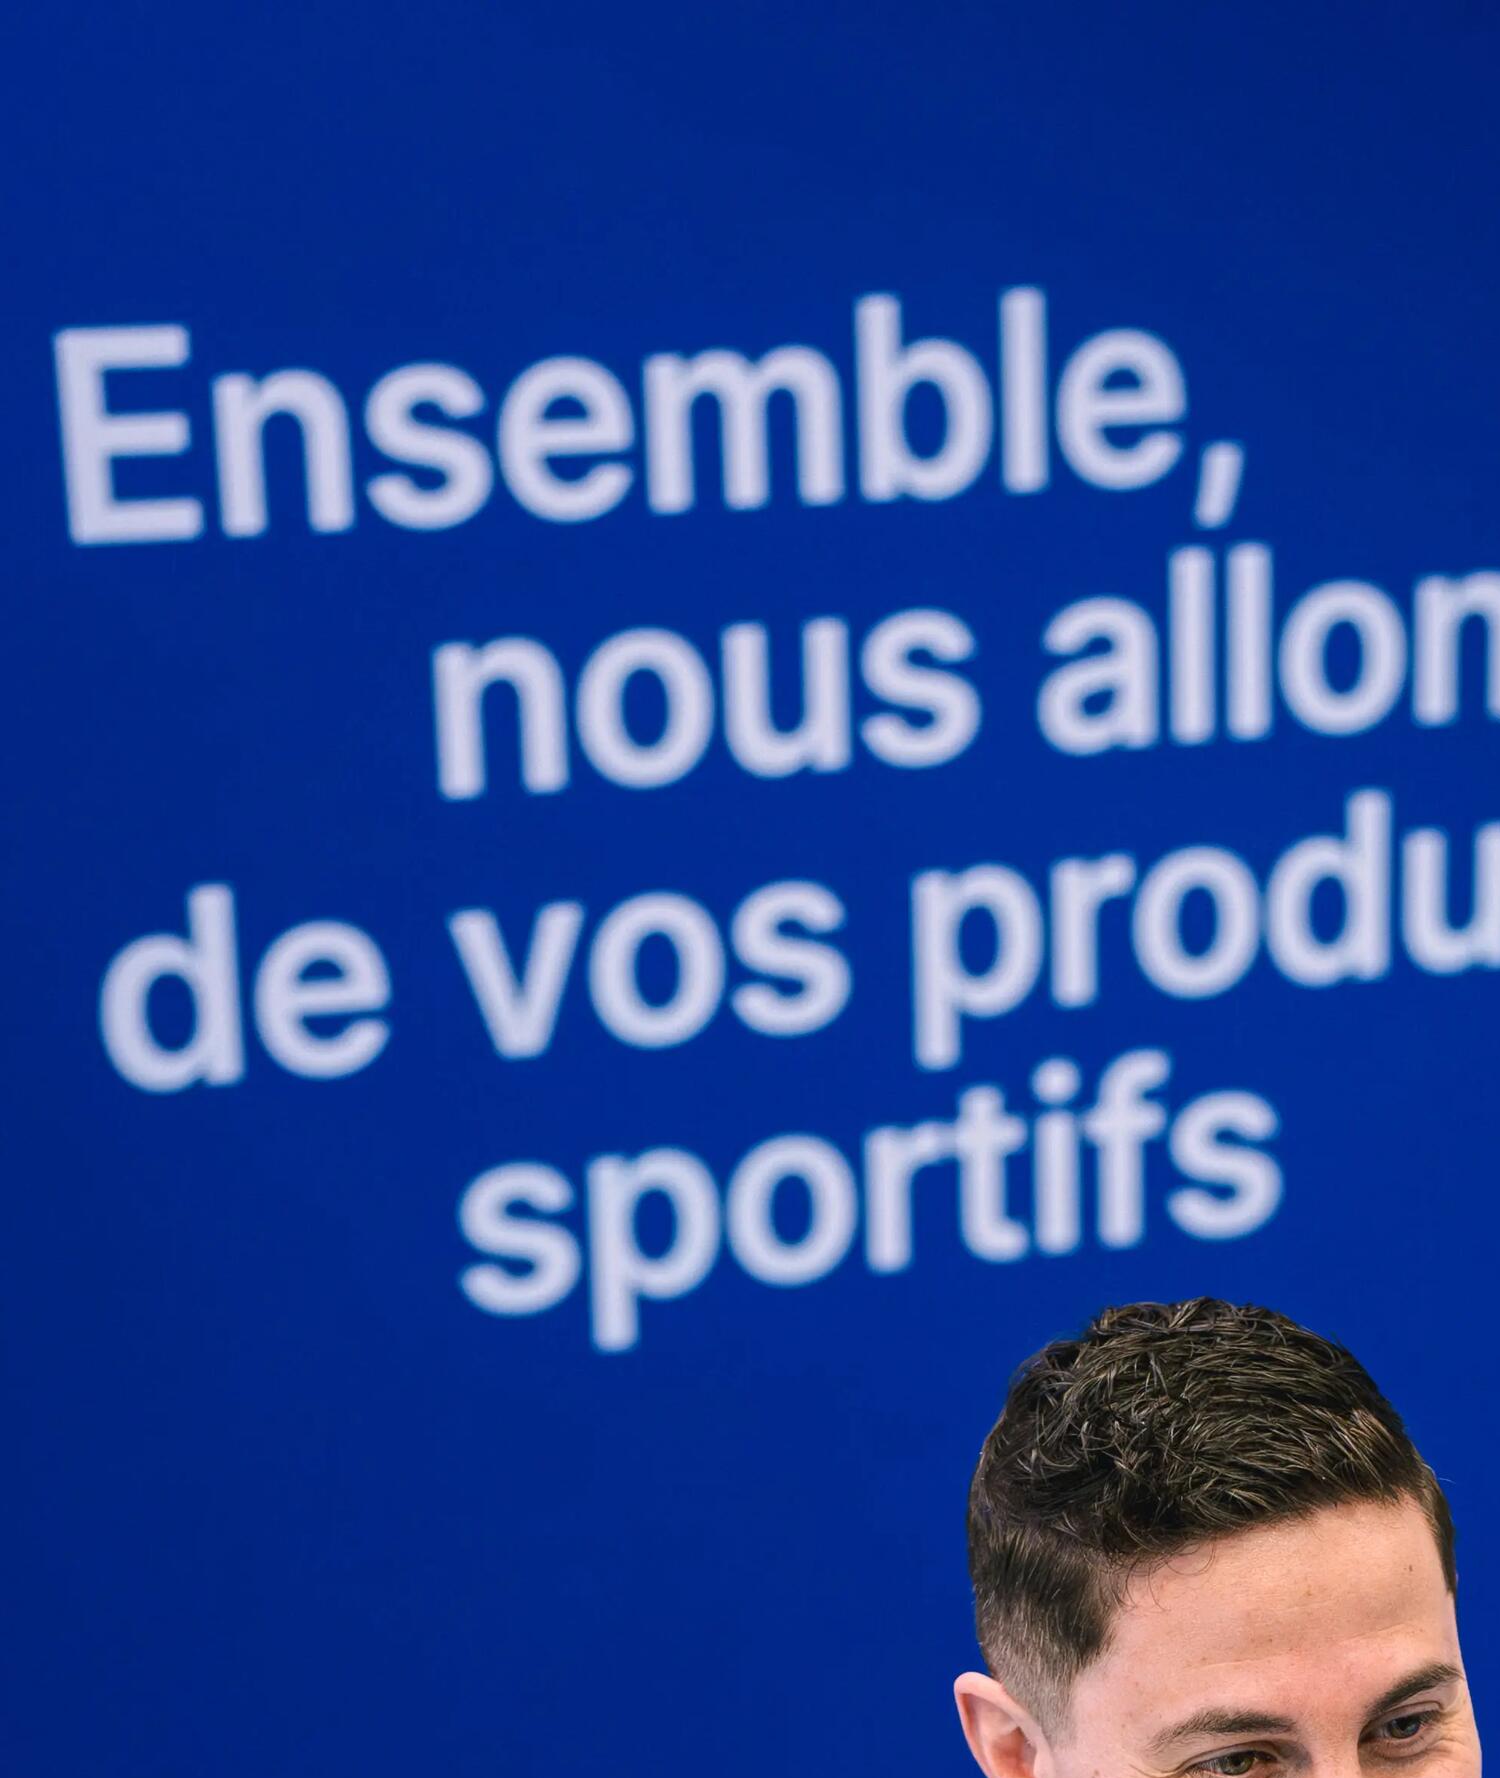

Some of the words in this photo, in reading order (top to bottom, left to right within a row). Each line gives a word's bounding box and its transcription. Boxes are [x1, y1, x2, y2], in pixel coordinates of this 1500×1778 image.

[54, 287, 1243, 545] Ensemble,
[433, 609, 980, 799] nous
[101, 884, 390, 1091] de
[450, 881, 850, 1058] vos
[461, 1049, 1282, 1351] sportifs
